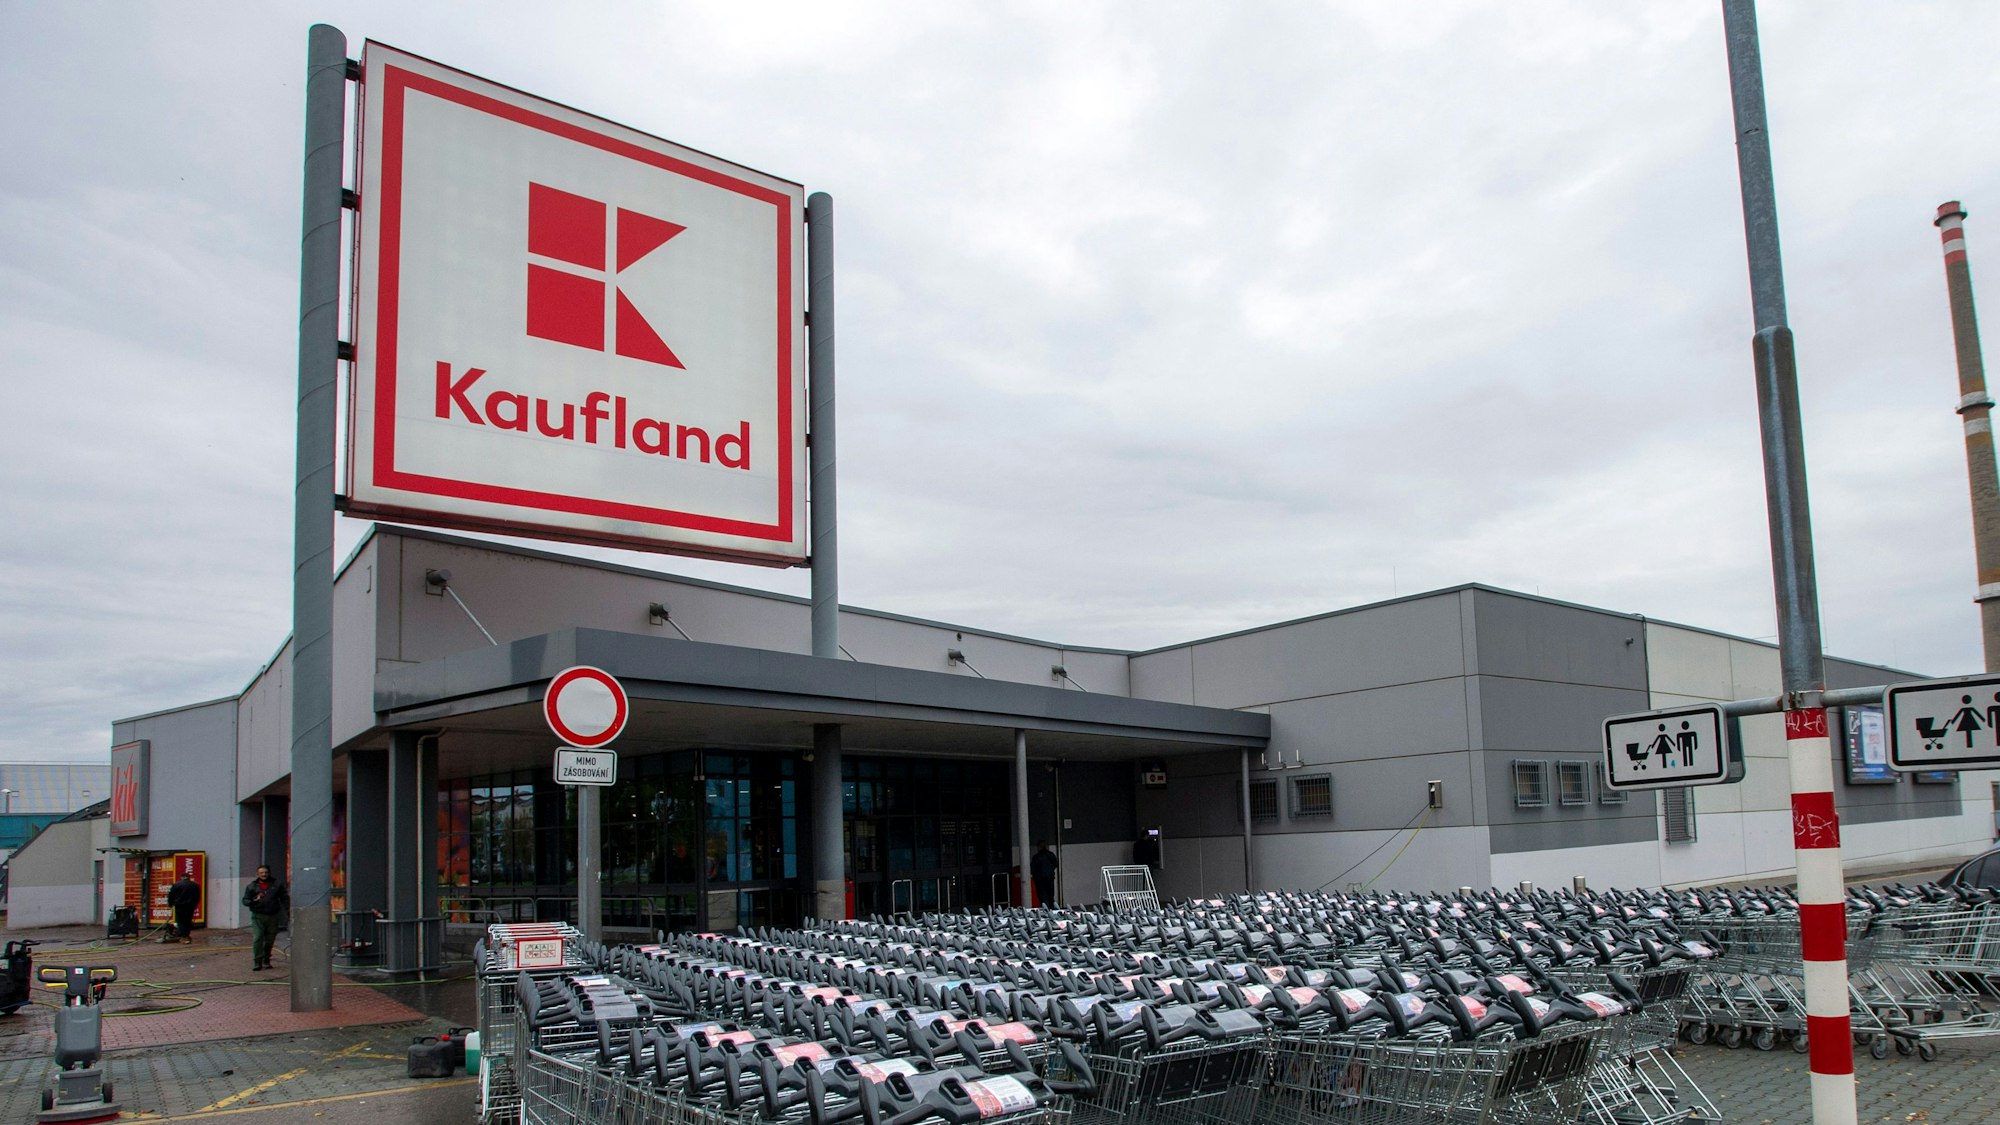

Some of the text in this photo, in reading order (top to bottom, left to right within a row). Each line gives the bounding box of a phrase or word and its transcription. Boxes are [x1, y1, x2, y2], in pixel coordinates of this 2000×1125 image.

[435, 360, 750, 470] Kaufland
[576, 757, 596, 766] MIMO
[563, 766, 610, 778] ZÁSOBOVÁNÍ
